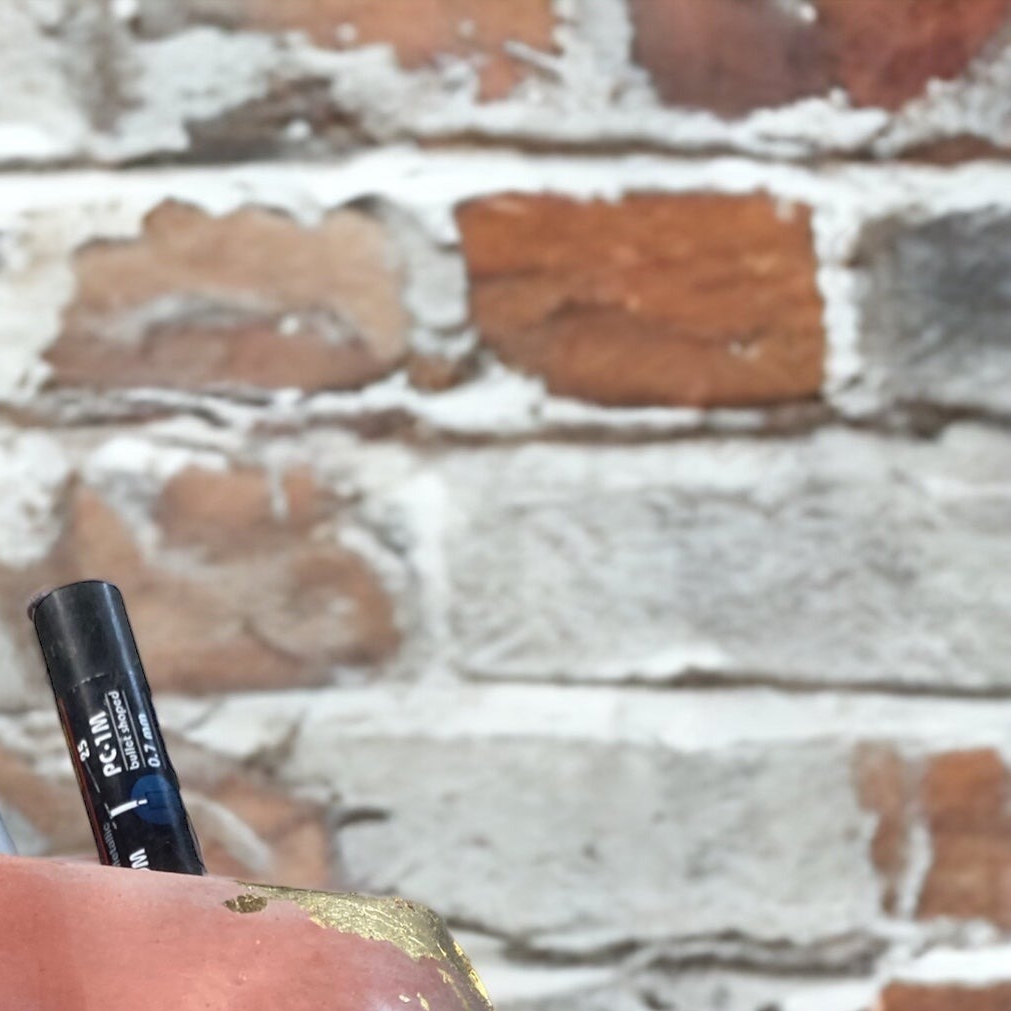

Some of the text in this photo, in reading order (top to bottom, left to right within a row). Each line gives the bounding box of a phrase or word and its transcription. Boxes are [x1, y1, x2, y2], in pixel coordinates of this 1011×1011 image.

[77, 738, 90, 763] 25
[108, 689, 139, 770] bullet shaped
[138, 712, 161, 768] 0.7 mm
